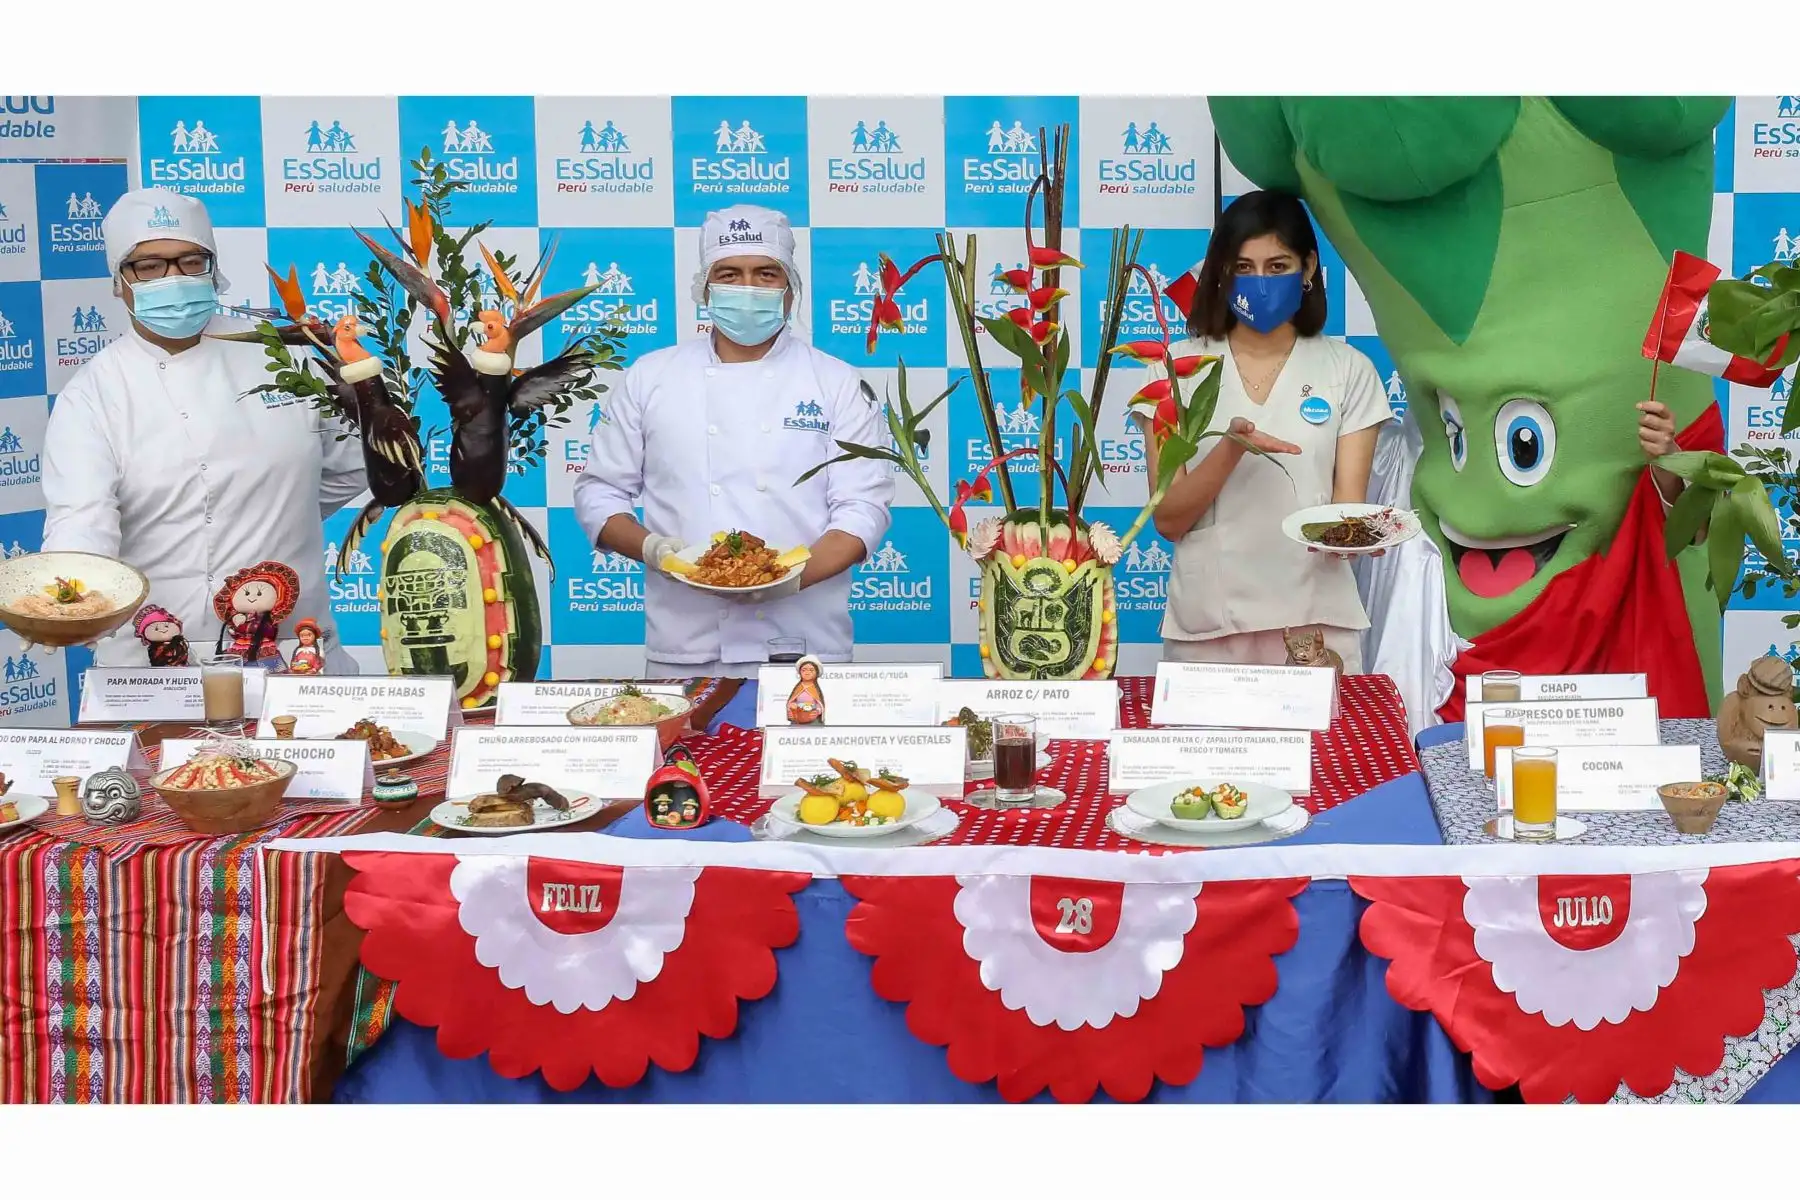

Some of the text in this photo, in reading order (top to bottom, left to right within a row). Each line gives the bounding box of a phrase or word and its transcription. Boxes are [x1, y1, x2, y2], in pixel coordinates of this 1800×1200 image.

[0, 120, 56, 138] dable
[1754, 147, 1782, 158] Perú
[151, 157, 245, 180] EsSalud
[283, 158, 381, 180] EsSalud
[556, 157, 654, 180] EsSalud
[692, 157, 790, 180] EsSalud
[828, 157, 925, 180] EsSalud
[1099, 158, 1196, 181] EsSalud
[184, 183, 245, 193] saludable
[284, 182, 381, 193] Perú saludable
[557, 182, 654, 193] Perú saludable
[693, 182, 790, 193] Perú saludable
[829, 182, 925, 193] Perú saludable
[965, 183, 994, 193] Perú
[1099, 183, 1195, 194] Perú saludable
[0, 245, 26, 254] dable
[52, 244, 74, 252] Perú
[831, 323, 860, 334] Perú
[58, 357, 79, 366] Perú
[784, 418, 830, 431] EsSalud
[1748, 430, 1775, 440] Perú
[568, 577, 645, 599] EsSalu
[850, 576, 931, 599] sSalud
[569, 601, 644, 612] Perú saluda
[848, 600, 931, 611] erú saludable
[171, 677, 198, 685] HUEVO
[0, 677, 56, 706] sSalud
[299, 685, 426, 698] MATASQUITA DE HABAS
[535, 686, 591, 697] ENSALADA
[594, 687, 609, 697] DE
[1540, 683, 1578, 693] CHAPO
[986, 689, 1070, 700] ARROZ C/ PATO
[14, 699, 57, 714] saludable
[1566, 708, 1581, 718] DE
[1584, 707, 1624, 718] TUMBO
[28, 736, 48, 744] PAPA
[49, 736, 58, 744] AL
[88, 737, 94, 745] Y
[95, 737, 126, 746] CHOCLO
[564, 735, 581, 743] CON
[615, 735, 638, 743] FRITO
[779, 735, 951, 745] CAUSA DE ANCHOVETA Y VEGETALES
[1123, 736, 1160, 744] ENSALADA
[1161, 736, 1171, 744] DE
[265, 748, 281, 759] DE
[284, 748, 335, 759] CHOCHO
[1582, 761, 1624, 771] COCONA
[541, 882, 602, 913] FELIZ
[1055, 898, 1093, 934] 28
[1553, 895, 1613, 928] JULIO
